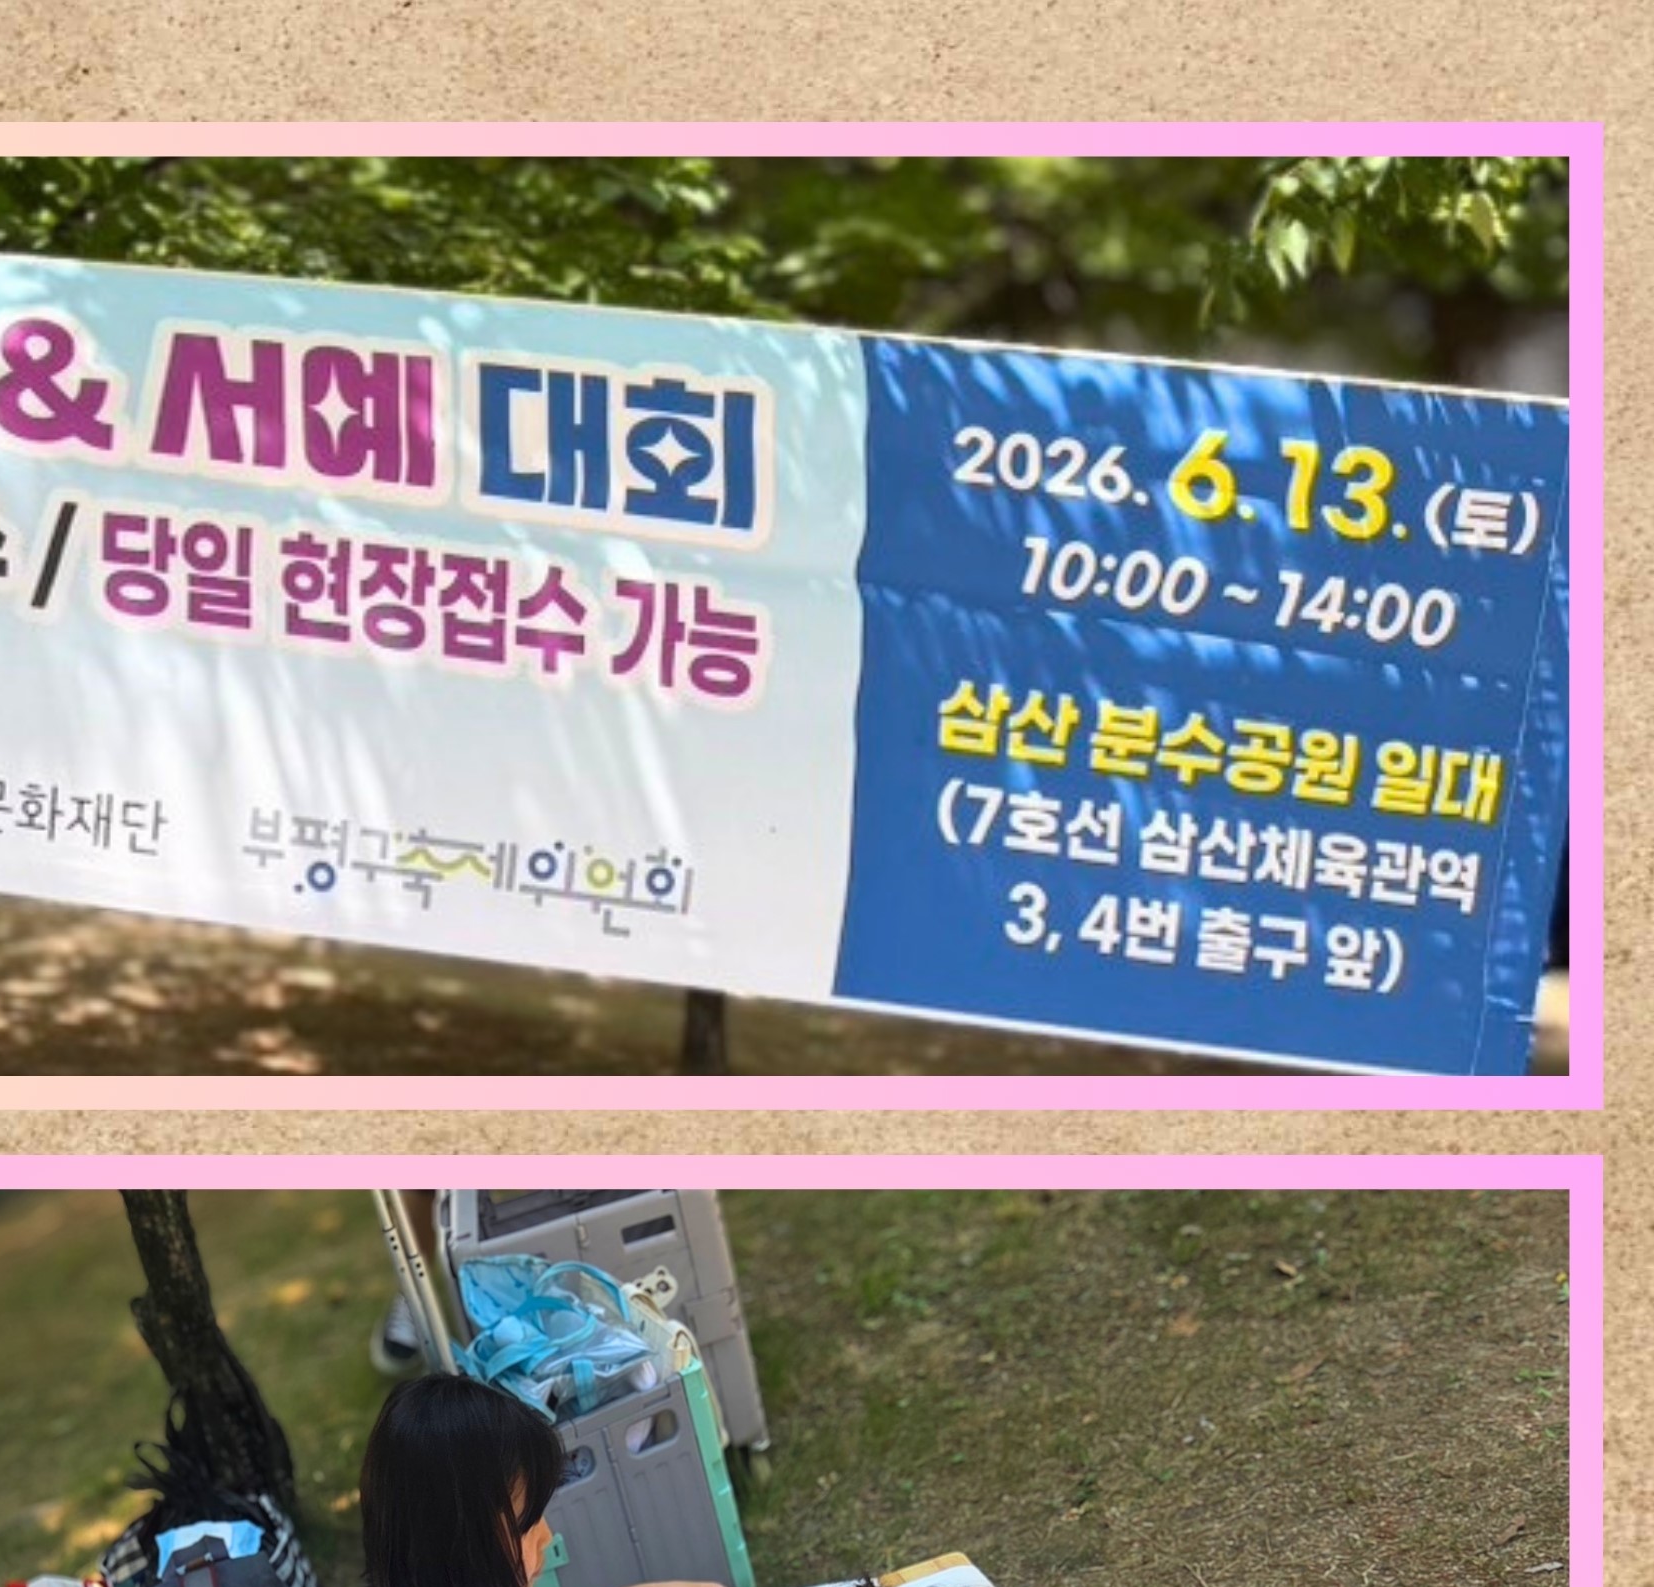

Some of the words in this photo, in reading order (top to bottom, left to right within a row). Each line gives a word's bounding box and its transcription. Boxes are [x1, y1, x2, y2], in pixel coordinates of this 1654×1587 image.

[150, 330, 437, 488] 서예
[478, 362, 757, 530] 대회
[952, 426, 1149, 507] 2026.
[1423, 483, 1541, 555] (토)
[30, 503, 78, 608] /
[101, 511, 254, 632] 당일
[279, 532, 590, 676] 현장접수
[611, 578, 760, 700] 가능
[1019, 536, 1209, 617] 10:00
[1273, 571, 1457, 648] 14:00
[936, 680, 1080, 764] 삼산
[1089, 699, 1360, 806] 분수공원
[1370, 741, 1504, 823] 일대
[936, 778, 1122, 864] (7호선
[1139, 810, 1482, 914] 삼산체육관역
[1005, 882, 1061, 953] 3,
[1078, 896, 1180, 965] 4번
[1196, 907, 1308, 981] 출구
[1323, 930, 1405, 993] 앞)
